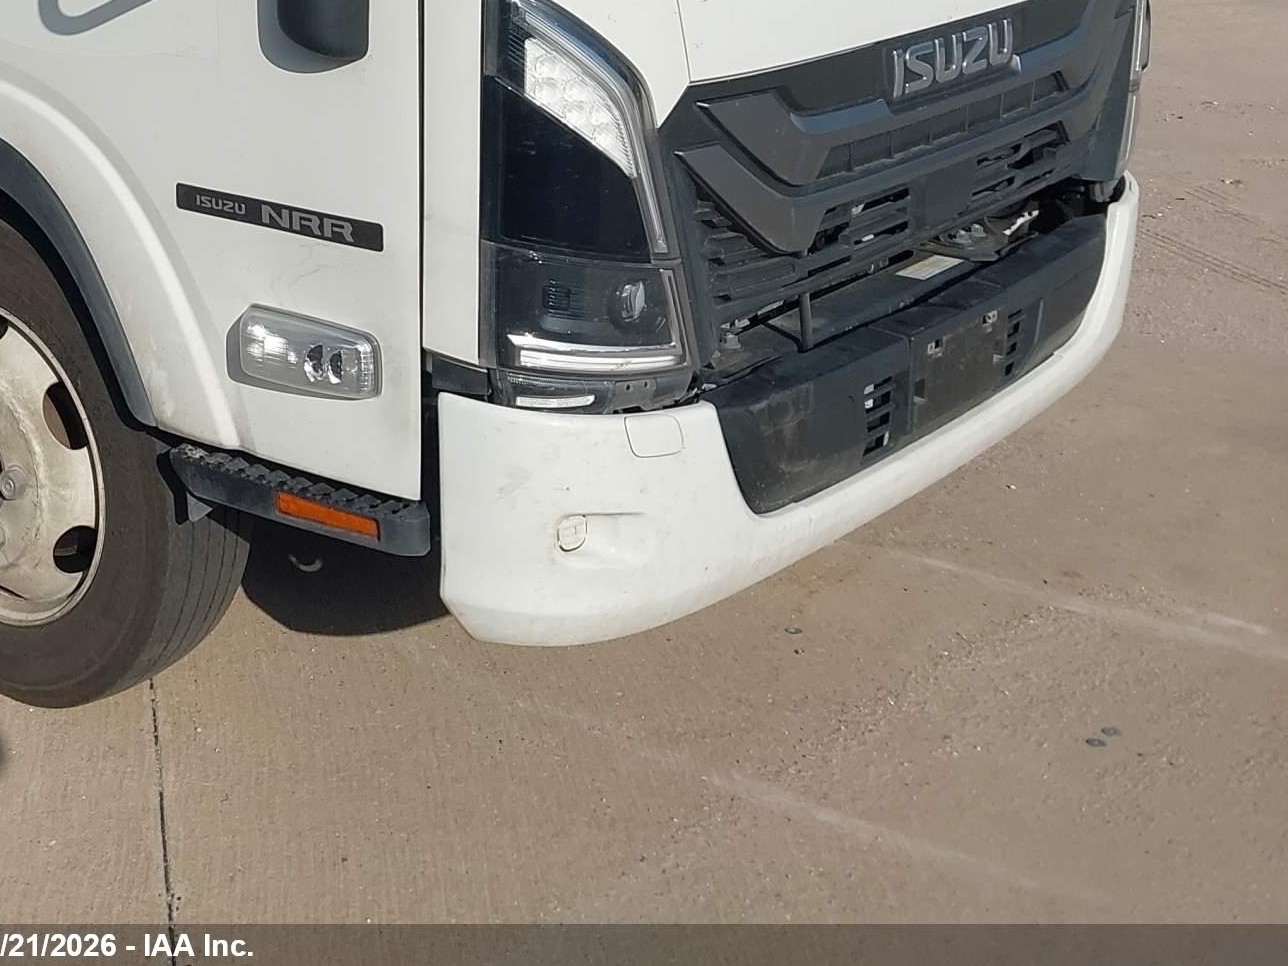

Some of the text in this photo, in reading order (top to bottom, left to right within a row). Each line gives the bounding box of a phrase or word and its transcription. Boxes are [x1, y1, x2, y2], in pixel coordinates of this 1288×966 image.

[892, 18, 1013, 99] ISUZU
[196, 194, 355, 243] ISUZU NRR
